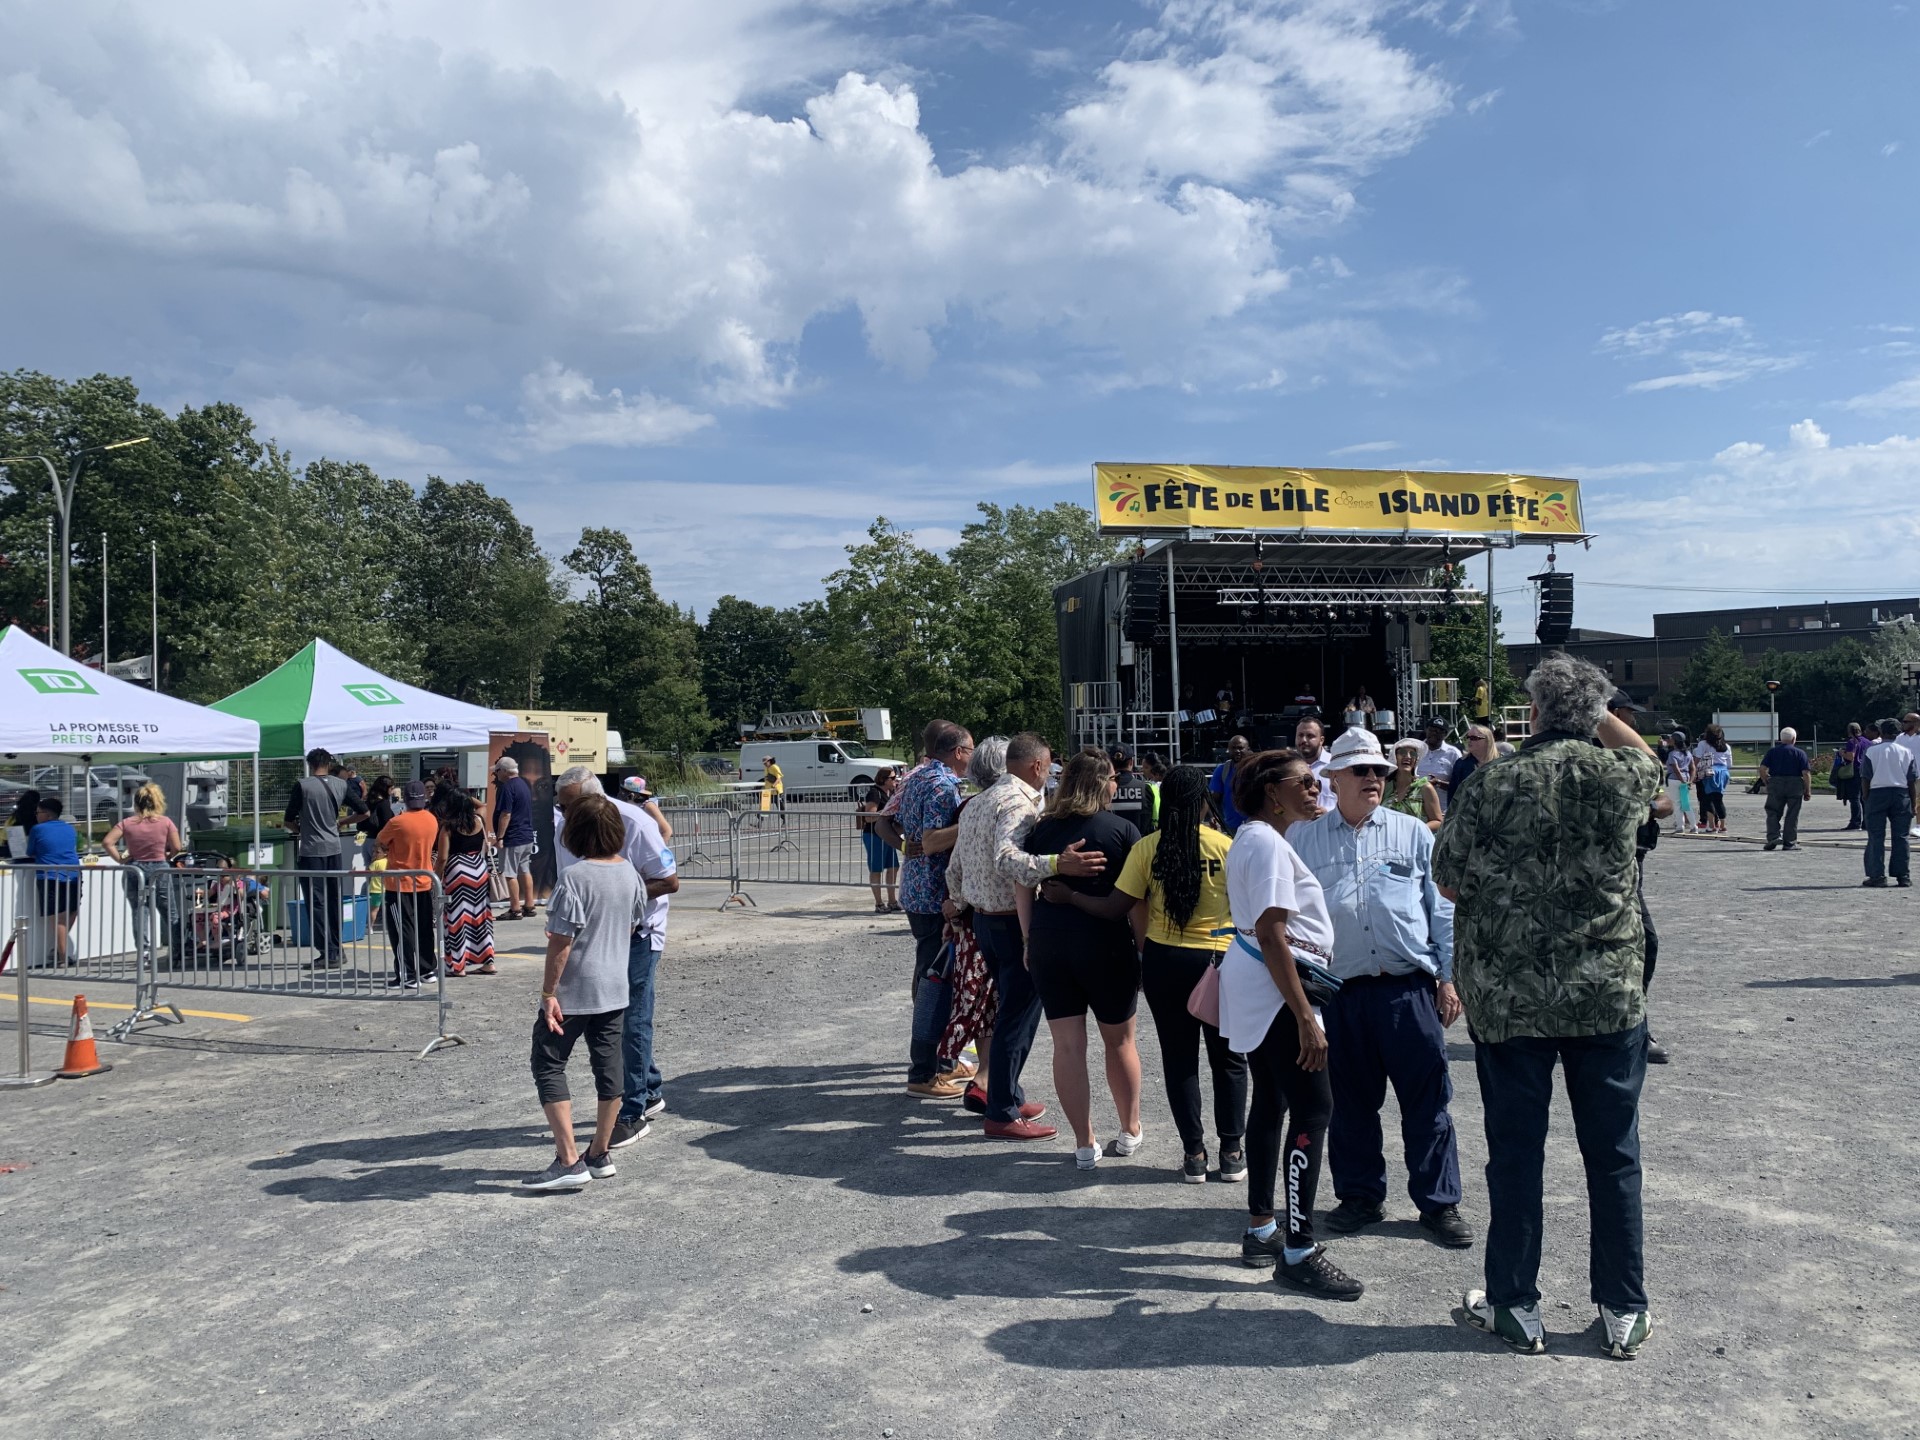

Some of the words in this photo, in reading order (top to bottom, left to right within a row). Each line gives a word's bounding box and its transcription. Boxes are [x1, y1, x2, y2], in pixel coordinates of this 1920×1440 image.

[1143, 478, 1219, 512] FÊTE
[1225, 492, 1253, 508] DE
[1378, 489, 1480, 517] ISLAND
[1486, 489, 1540, 521] FÊTE
[26, 673, 85, 689] TD
[349, 688, 392, 702] TD
[50, 723, 67, 731] LA
[70, 723, 140, 732] PROMESSE
[142, 724, 159, 733] TD
[383, 725, 394, 733] LA
[395, 723, 439, 732] PROMESSE
[52, 732, 93, 744] PRÊTS
[96, 732, 106, 744] À
[109, 734, 139, 744] AGIR
[383, 733, 409, 743] PRÊTS
[410, 732, 417, 741] À
[418, 733, 438, 741] AGIR
[1112, 788, 1142, 800] OLICE
[1289, 1149, 1308, 1234] Canada
